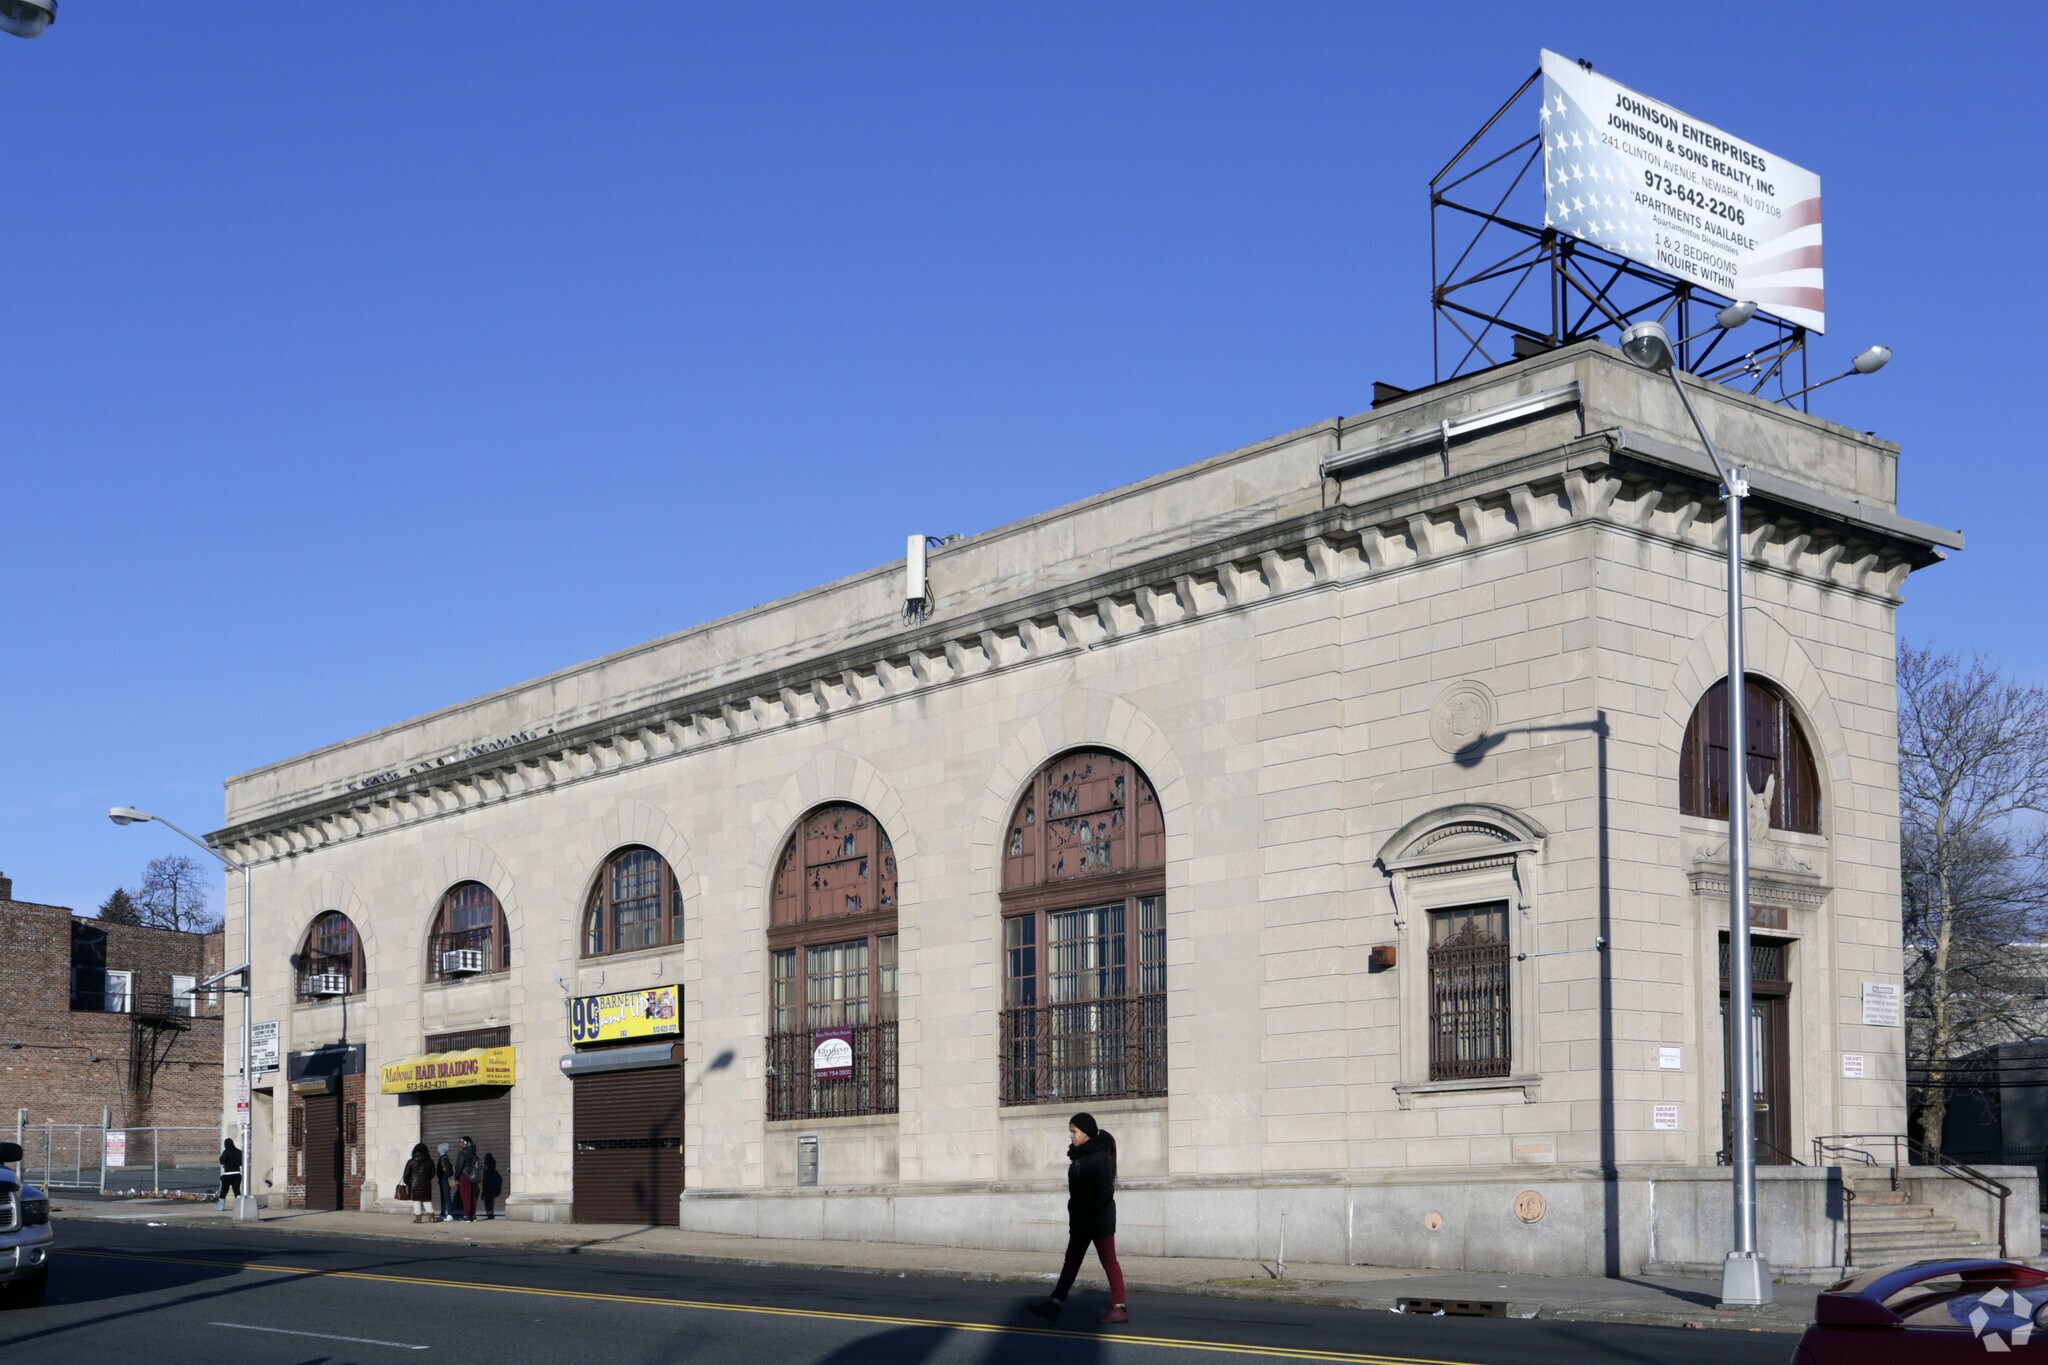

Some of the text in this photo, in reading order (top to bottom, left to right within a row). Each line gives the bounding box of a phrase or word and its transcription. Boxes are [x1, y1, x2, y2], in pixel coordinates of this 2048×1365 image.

[1615, 93, 1766, 172] JOHNSON ENTERPRISES
[1601, 132, 1782, 219] 241 CLINTON AVENUE, NEWARK, NJ 07108
[1607, 113, 1775, 197] JOHNSON & SONS REALTY, INC
[1644, 169, 1745, 226] 973-642-2206
[1652, 214, 1739, 256] Apartamentos Disponibles
[1654, 232, 1738, 276] 1 & 2 BEDROOMS
[1656, 248, 1735, 290] INQUIRE WITHIN
[572, 996, 600, 1041] 99
[600, 1003, 626, 1027] and
[629, 996, 650, 1018] UP
[406, 1080, 447, 1091] 973-643-4311
[415, 1064, 436, 1080] HAIR
[437, 1059, 479, 1078] BRAIDING
